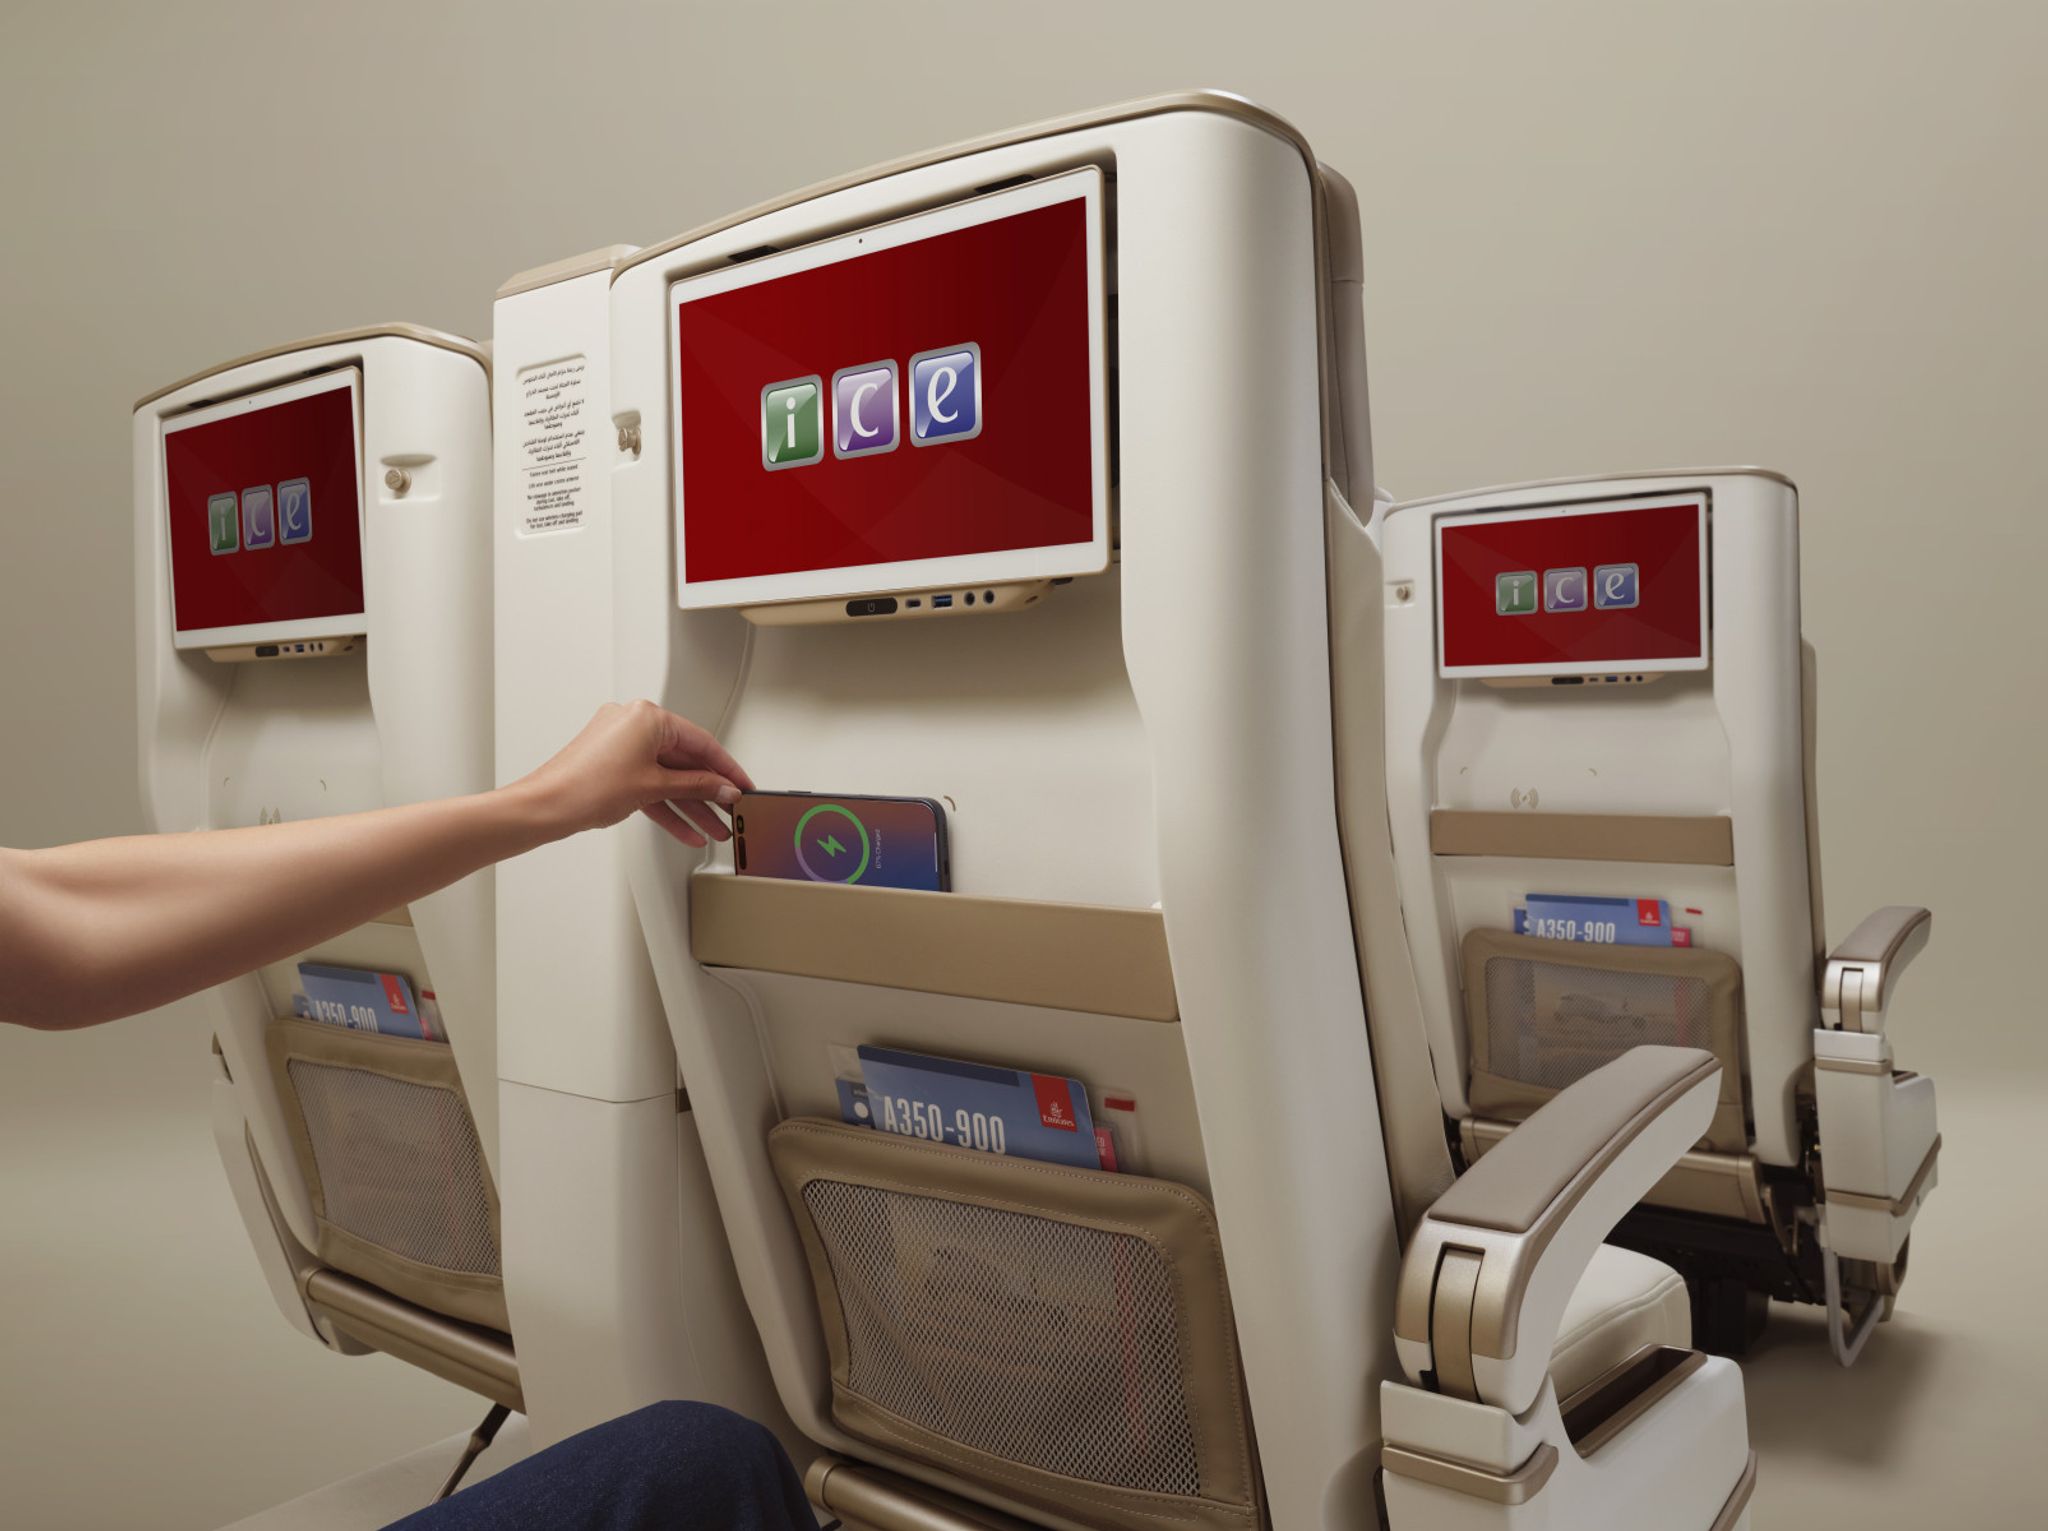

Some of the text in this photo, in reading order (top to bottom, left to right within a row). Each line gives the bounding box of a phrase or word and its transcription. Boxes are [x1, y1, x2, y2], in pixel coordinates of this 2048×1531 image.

[783, 363, 963, 452] ice
[1510, 570, 1627, 608] ice
[1536, 918, 1616, 944] A350-900
[883, 1095, 1007, 1156] A350-900
